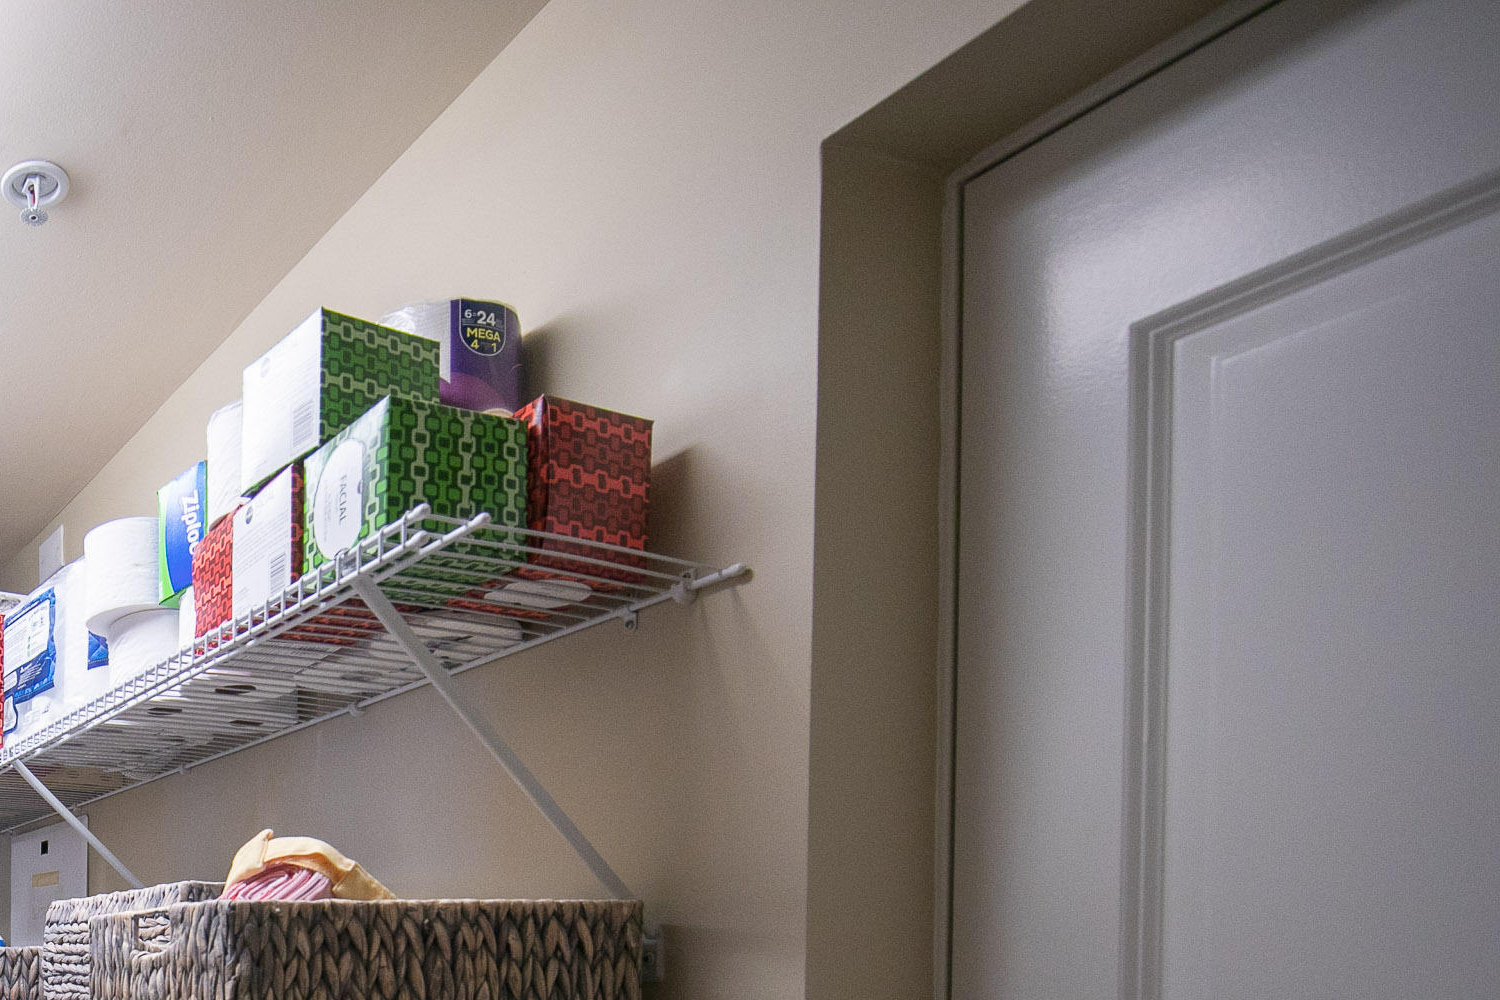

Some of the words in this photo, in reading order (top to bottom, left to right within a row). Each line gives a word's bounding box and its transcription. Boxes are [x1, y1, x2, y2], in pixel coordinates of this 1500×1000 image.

[466, 328, 501, 342] MEGA
[471, 339, 479, 349] 4
[491, 343, 497, 352] 1
